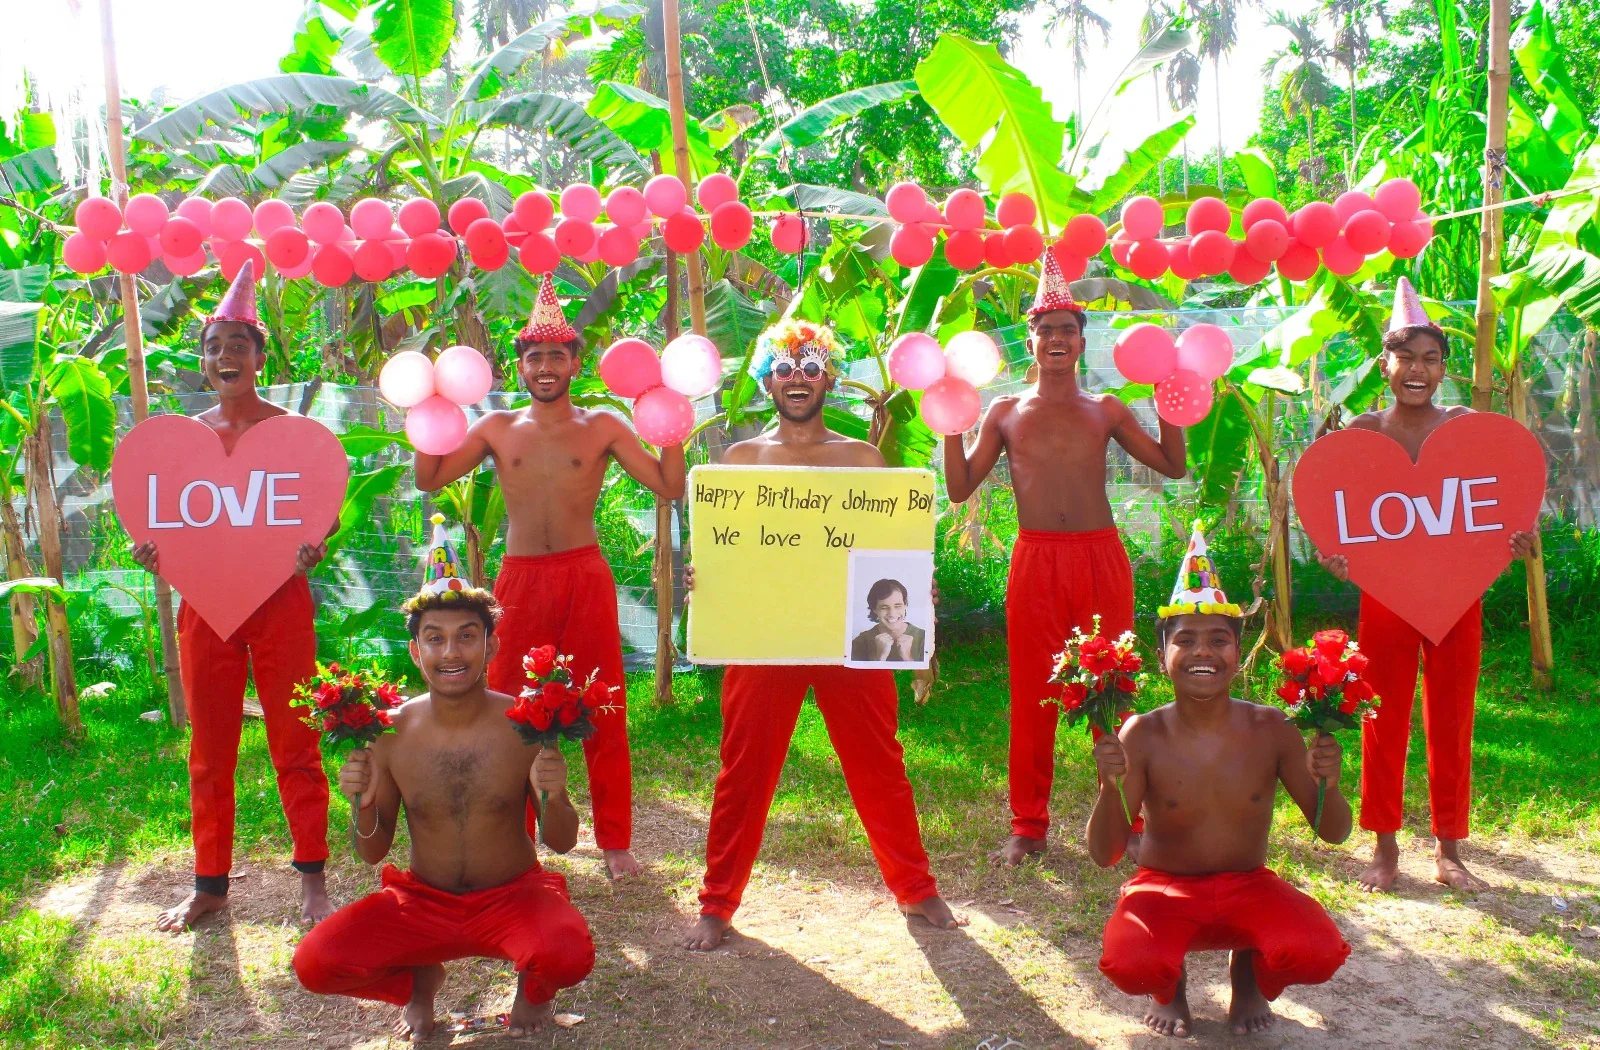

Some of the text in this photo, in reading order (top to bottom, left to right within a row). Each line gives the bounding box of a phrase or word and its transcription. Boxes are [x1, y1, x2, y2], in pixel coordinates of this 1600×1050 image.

[148, 470, 302, 529] LOVE
[695, 483, 935, 518] Happy Birthday Johnny Boy
[1334, 476, 1504, 545] LOVE
[712, 524, 855, 548] We love You
